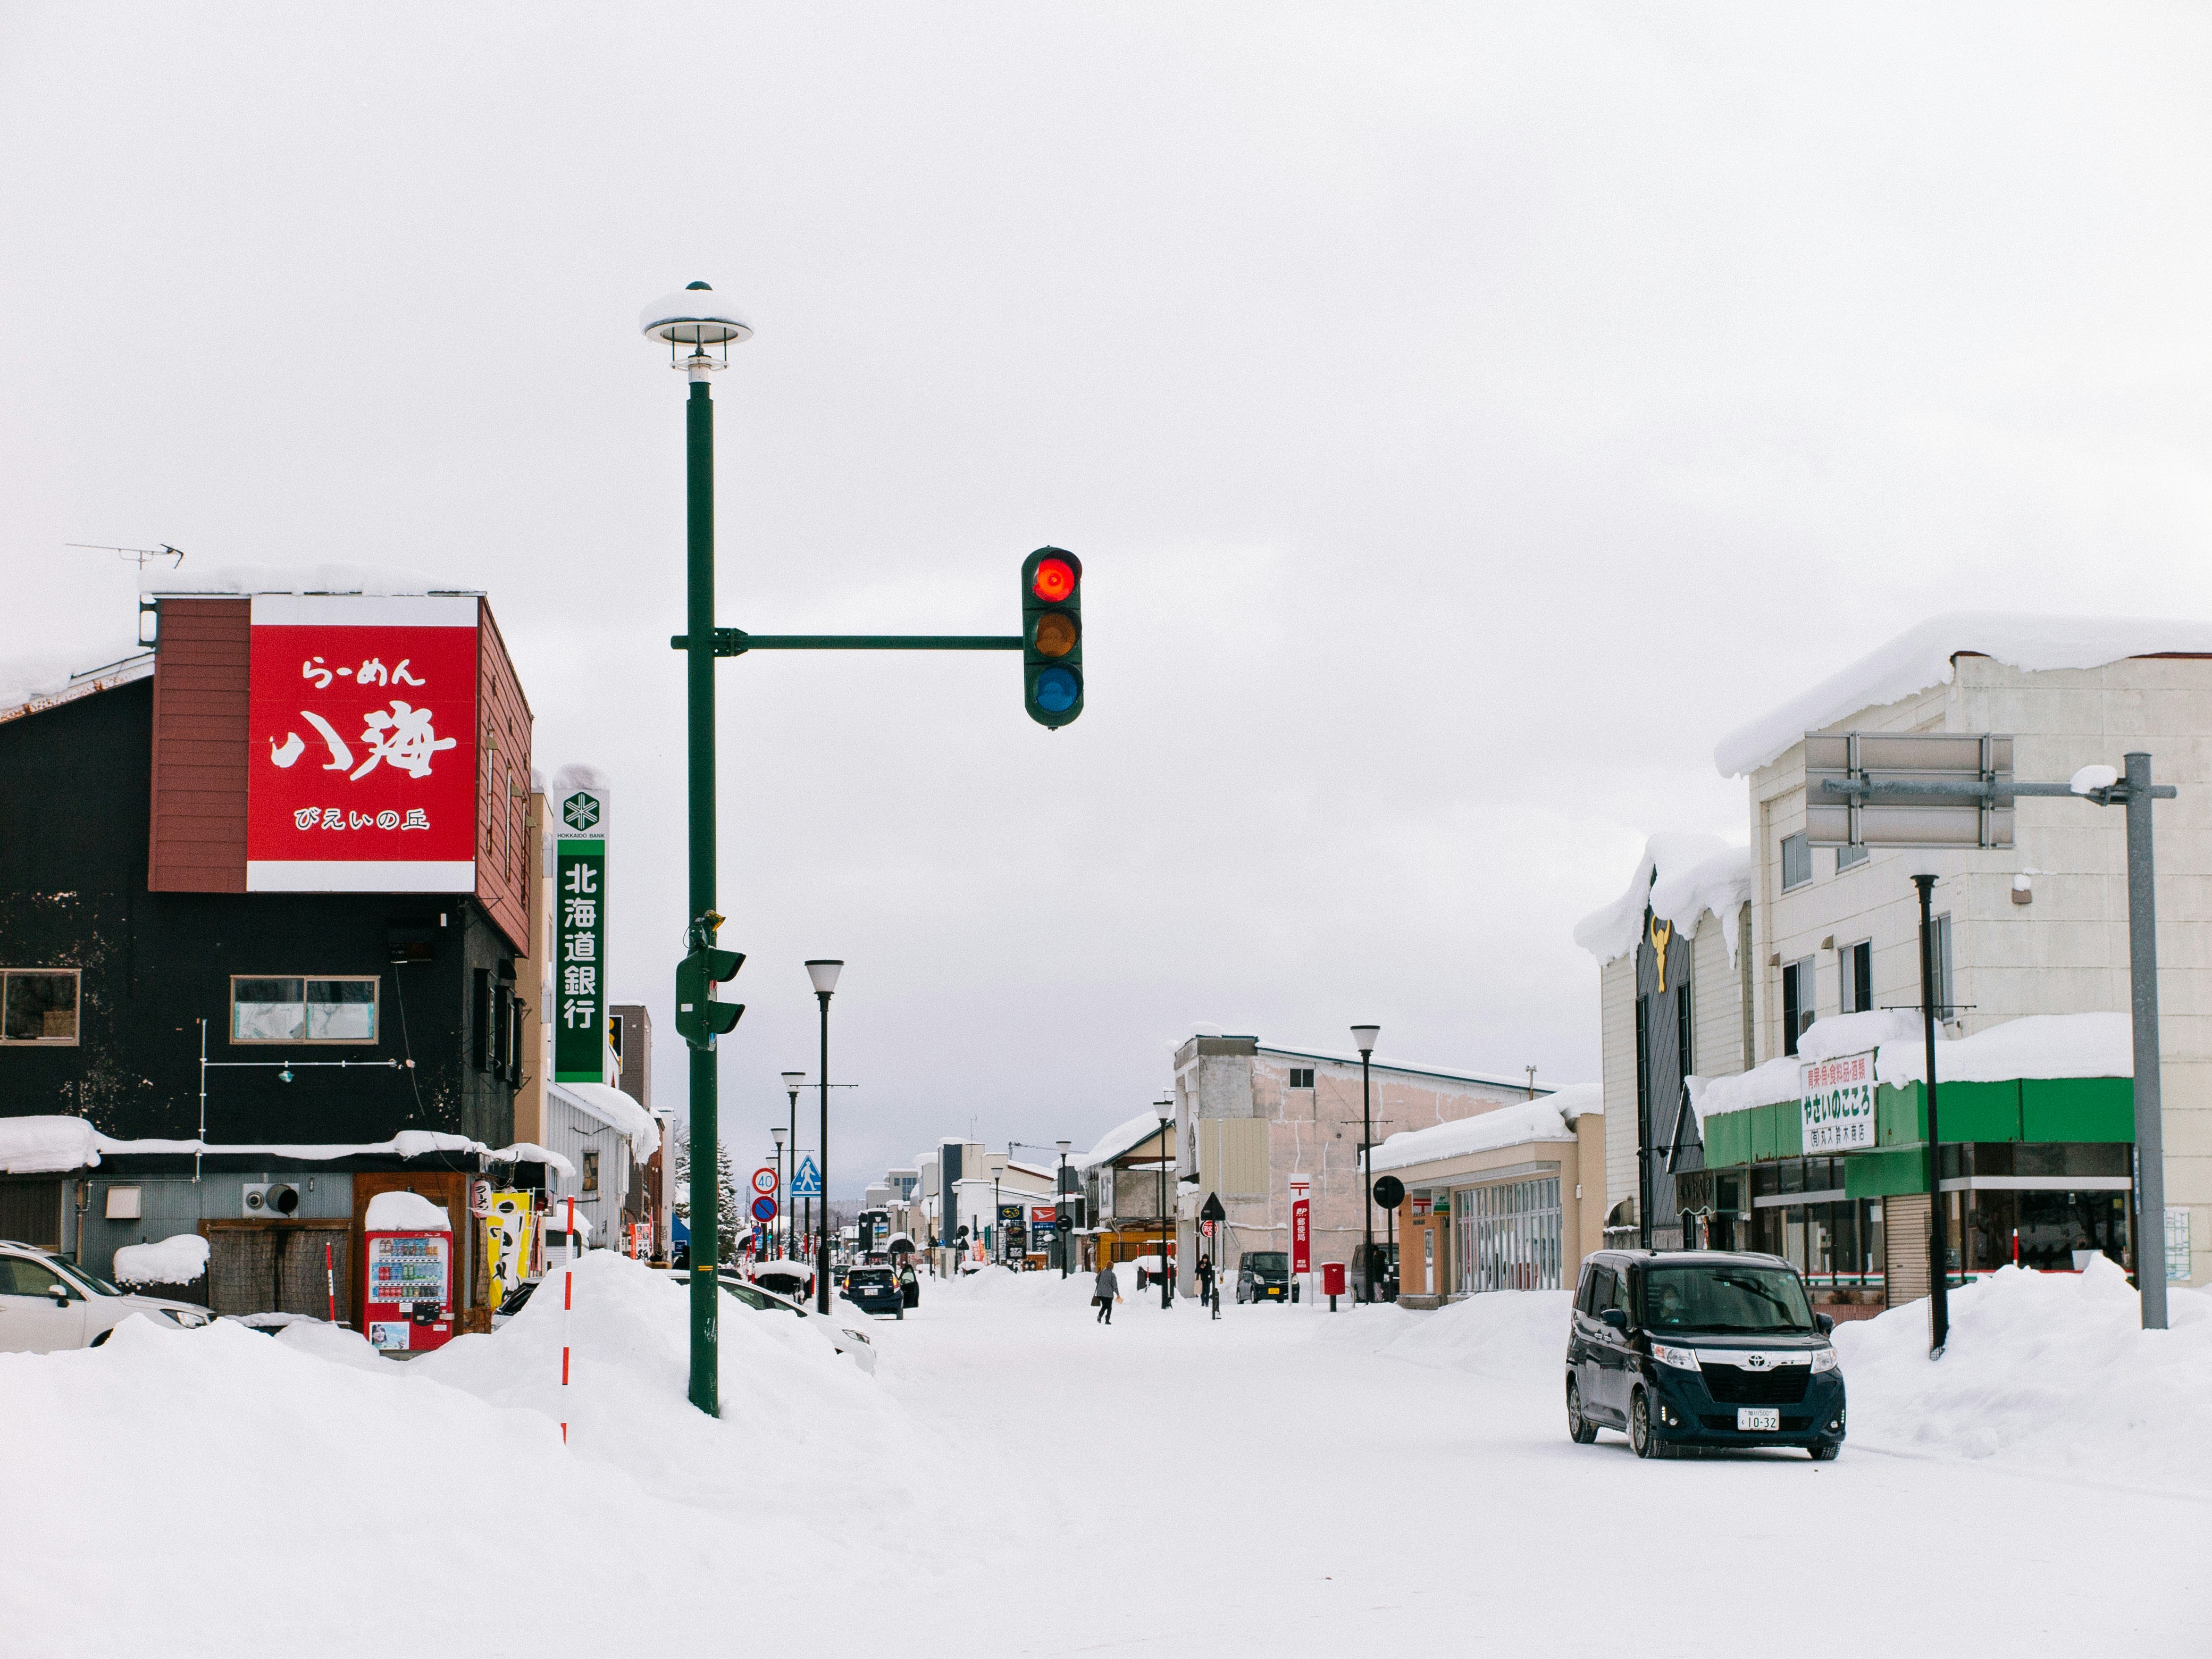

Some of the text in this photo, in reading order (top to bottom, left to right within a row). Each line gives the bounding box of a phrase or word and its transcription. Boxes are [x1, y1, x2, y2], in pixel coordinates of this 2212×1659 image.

[302, 656, 426, 690] らーめん
[270, 700, 457, 782] 八海
[294, 807, 431, 831] びえいの丘
[564, 862, 597, 1029] 北海道銀行
[1804, 1084, 1871, 1125] やさいのこころ
[758, 1175, 773, 1187] 40
[1748, 1417, 1776, 1428] 10-32
